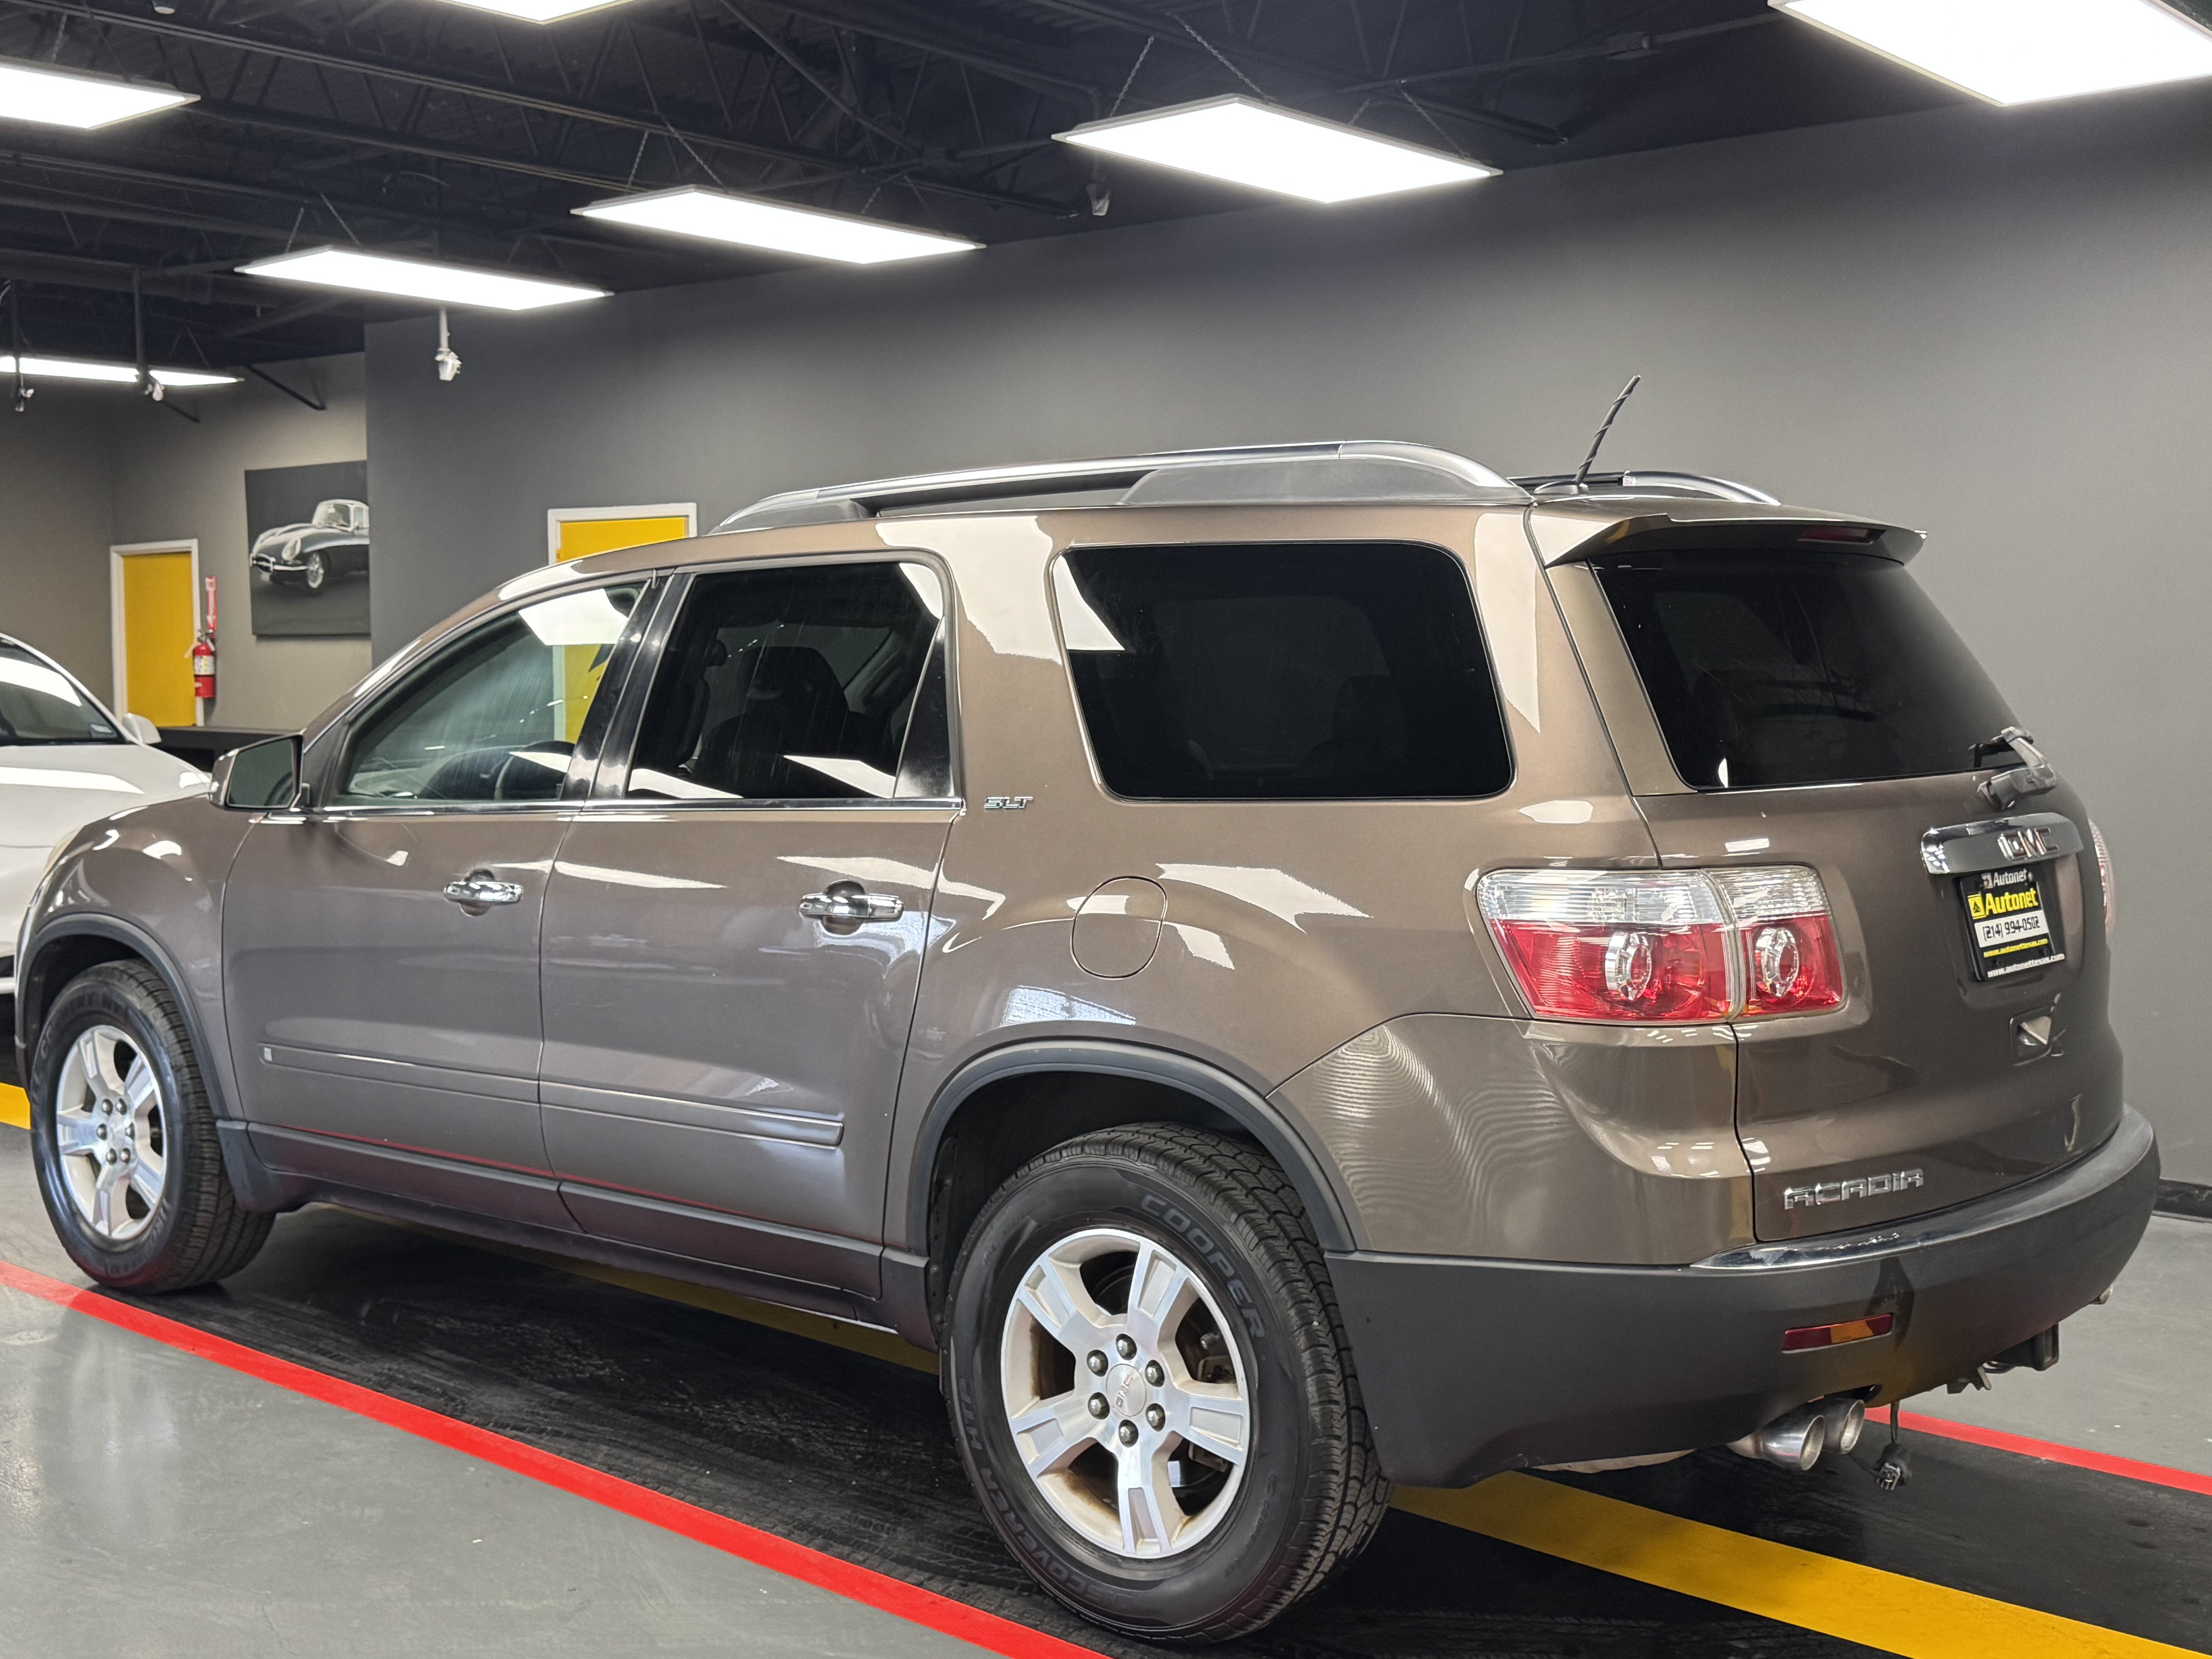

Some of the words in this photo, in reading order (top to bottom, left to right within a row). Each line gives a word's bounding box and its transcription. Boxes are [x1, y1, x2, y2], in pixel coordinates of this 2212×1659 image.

[984, 796, 1033, 809] SLT
[1997, 828, 2058, 861] GMC
[1993, 869, 2027, 886] Autonet
[1985, 888, 2039, 915] Autonet
[1983, 923, 2003, 941] (214)
[2004, 916, 2040, 934] 994-0502
[1784, 1168, 1923, 1209] ACADIA
[1140, 1194, 1265, 1338] COOPER
[1115, 1374, 1133, 1408] GMC
